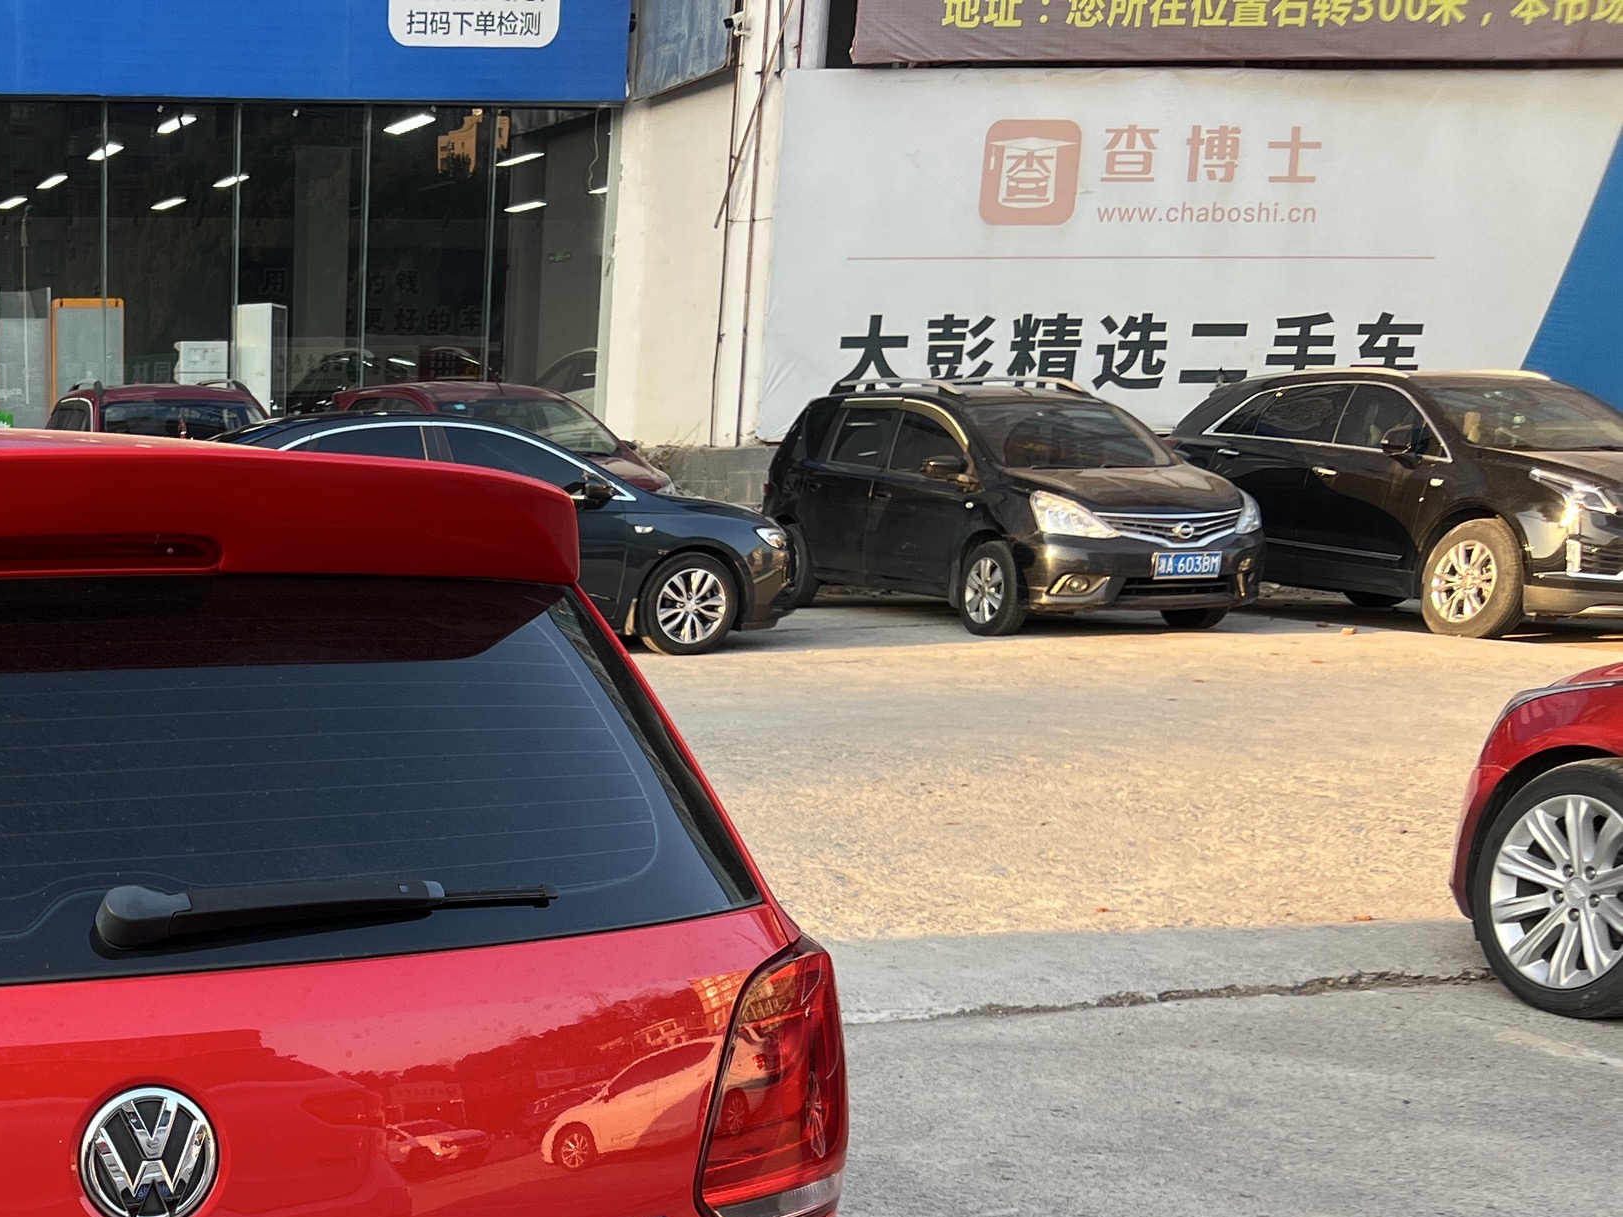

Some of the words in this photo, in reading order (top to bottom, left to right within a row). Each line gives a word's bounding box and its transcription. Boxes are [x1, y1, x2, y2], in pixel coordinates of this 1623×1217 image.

[406, 10, 541, 36] 扫码下单检测
[1100, 124, 1322, 183] 查博士
[1097, 202, 1317, 223] www.chaboshi.cn
[838, 311, 1425, 389] 大彭精选二手车
